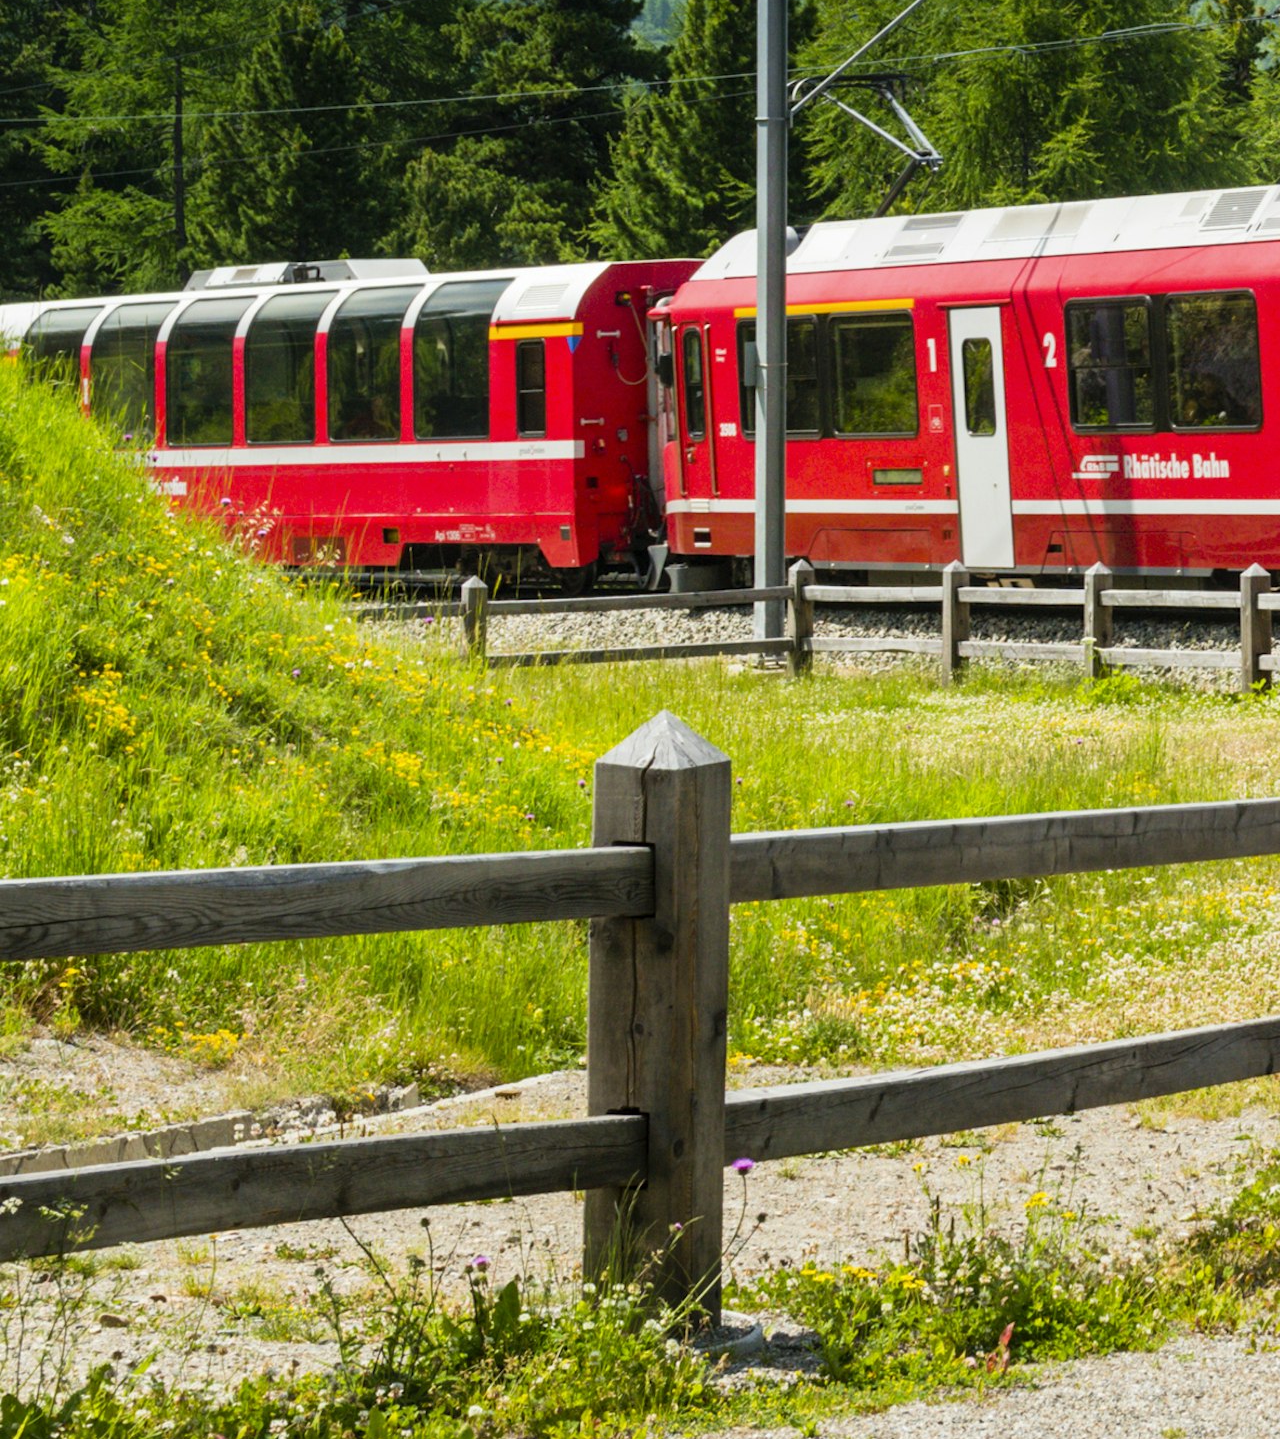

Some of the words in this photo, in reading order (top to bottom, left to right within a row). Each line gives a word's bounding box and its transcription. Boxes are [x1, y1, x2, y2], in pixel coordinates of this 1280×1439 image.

[926, 338, 938, 373] 1
[1042, 332, 1057, 368] 2
[1123, 452, 1190, 479] Rhätische
[1192, 451, 1230, 479] Bahn
